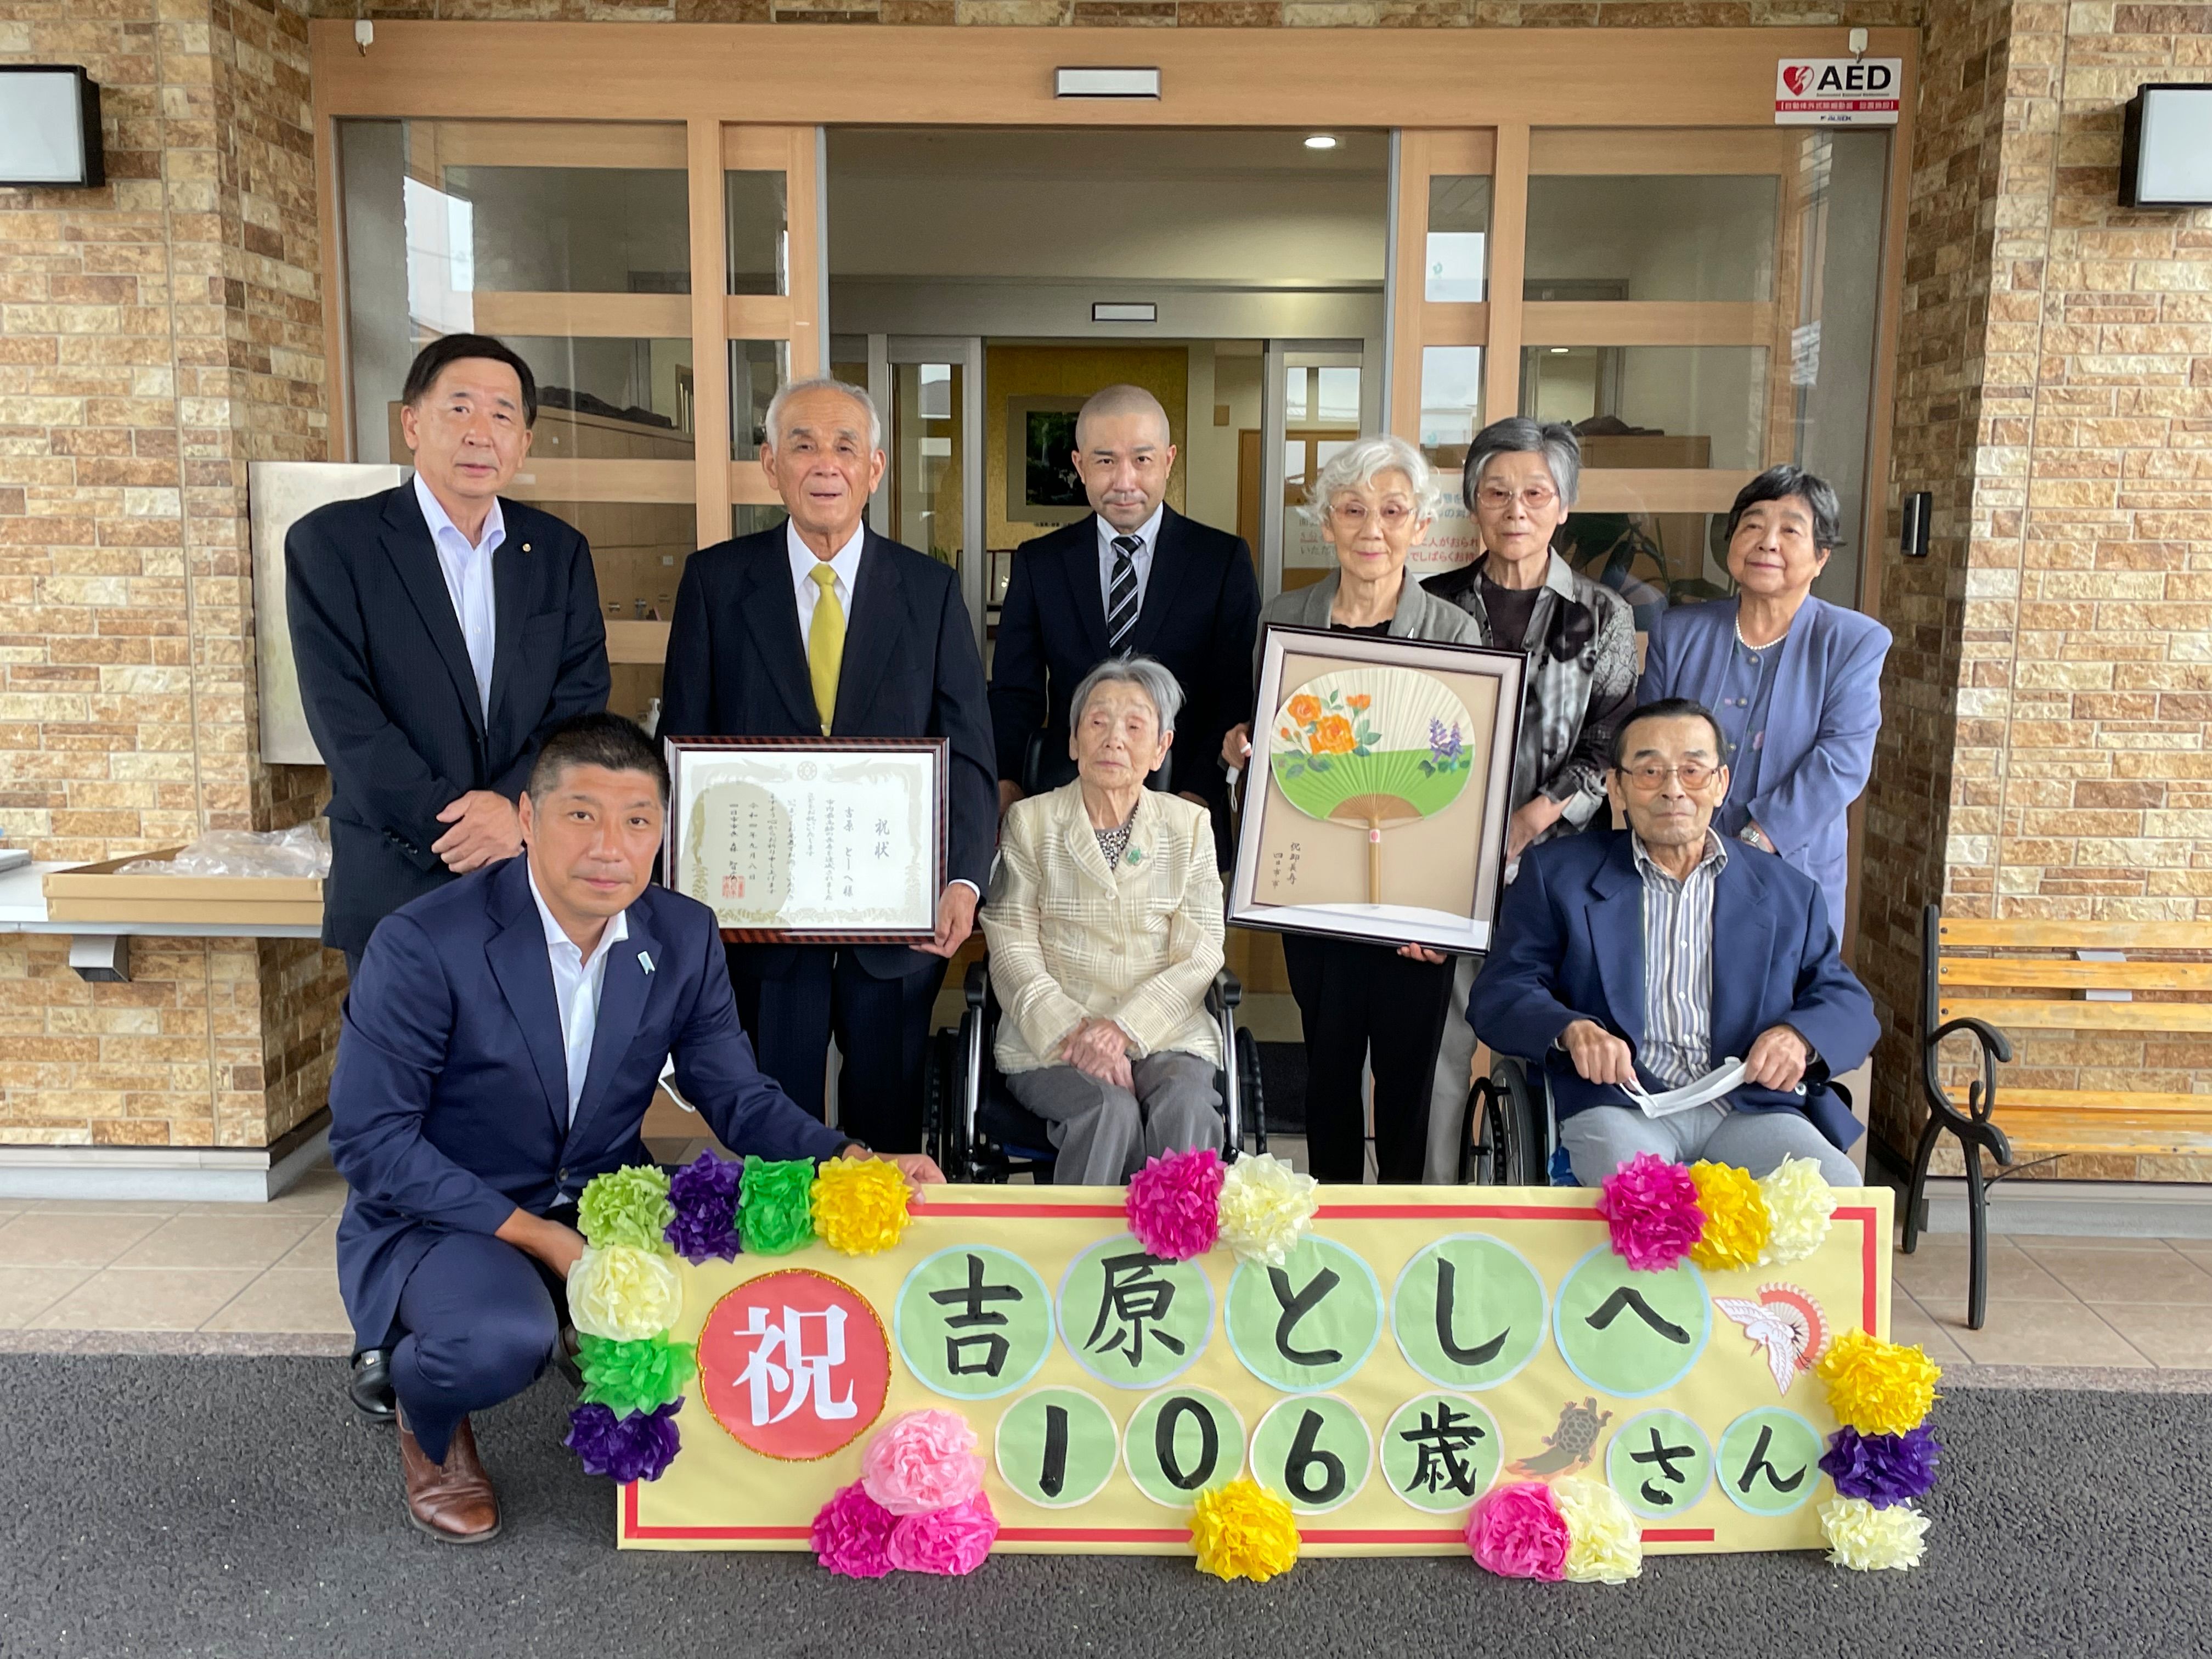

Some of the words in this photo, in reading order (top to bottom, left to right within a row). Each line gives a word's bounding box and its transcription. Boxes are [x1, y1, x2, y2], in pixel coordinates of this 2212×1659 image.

[1816, 65, 1892, 91] AED
[874, 818, 890, 860] 祝状
[1272, 852, 1284, 889] 四日市市
[929, 1251, 1690, 1376] 吉原としへ
[733, 1304, 857, 1426] 祝
[1039, 1397, 1485, 1503] 106歳
[1630, 1425, 1807, 1505] さん
